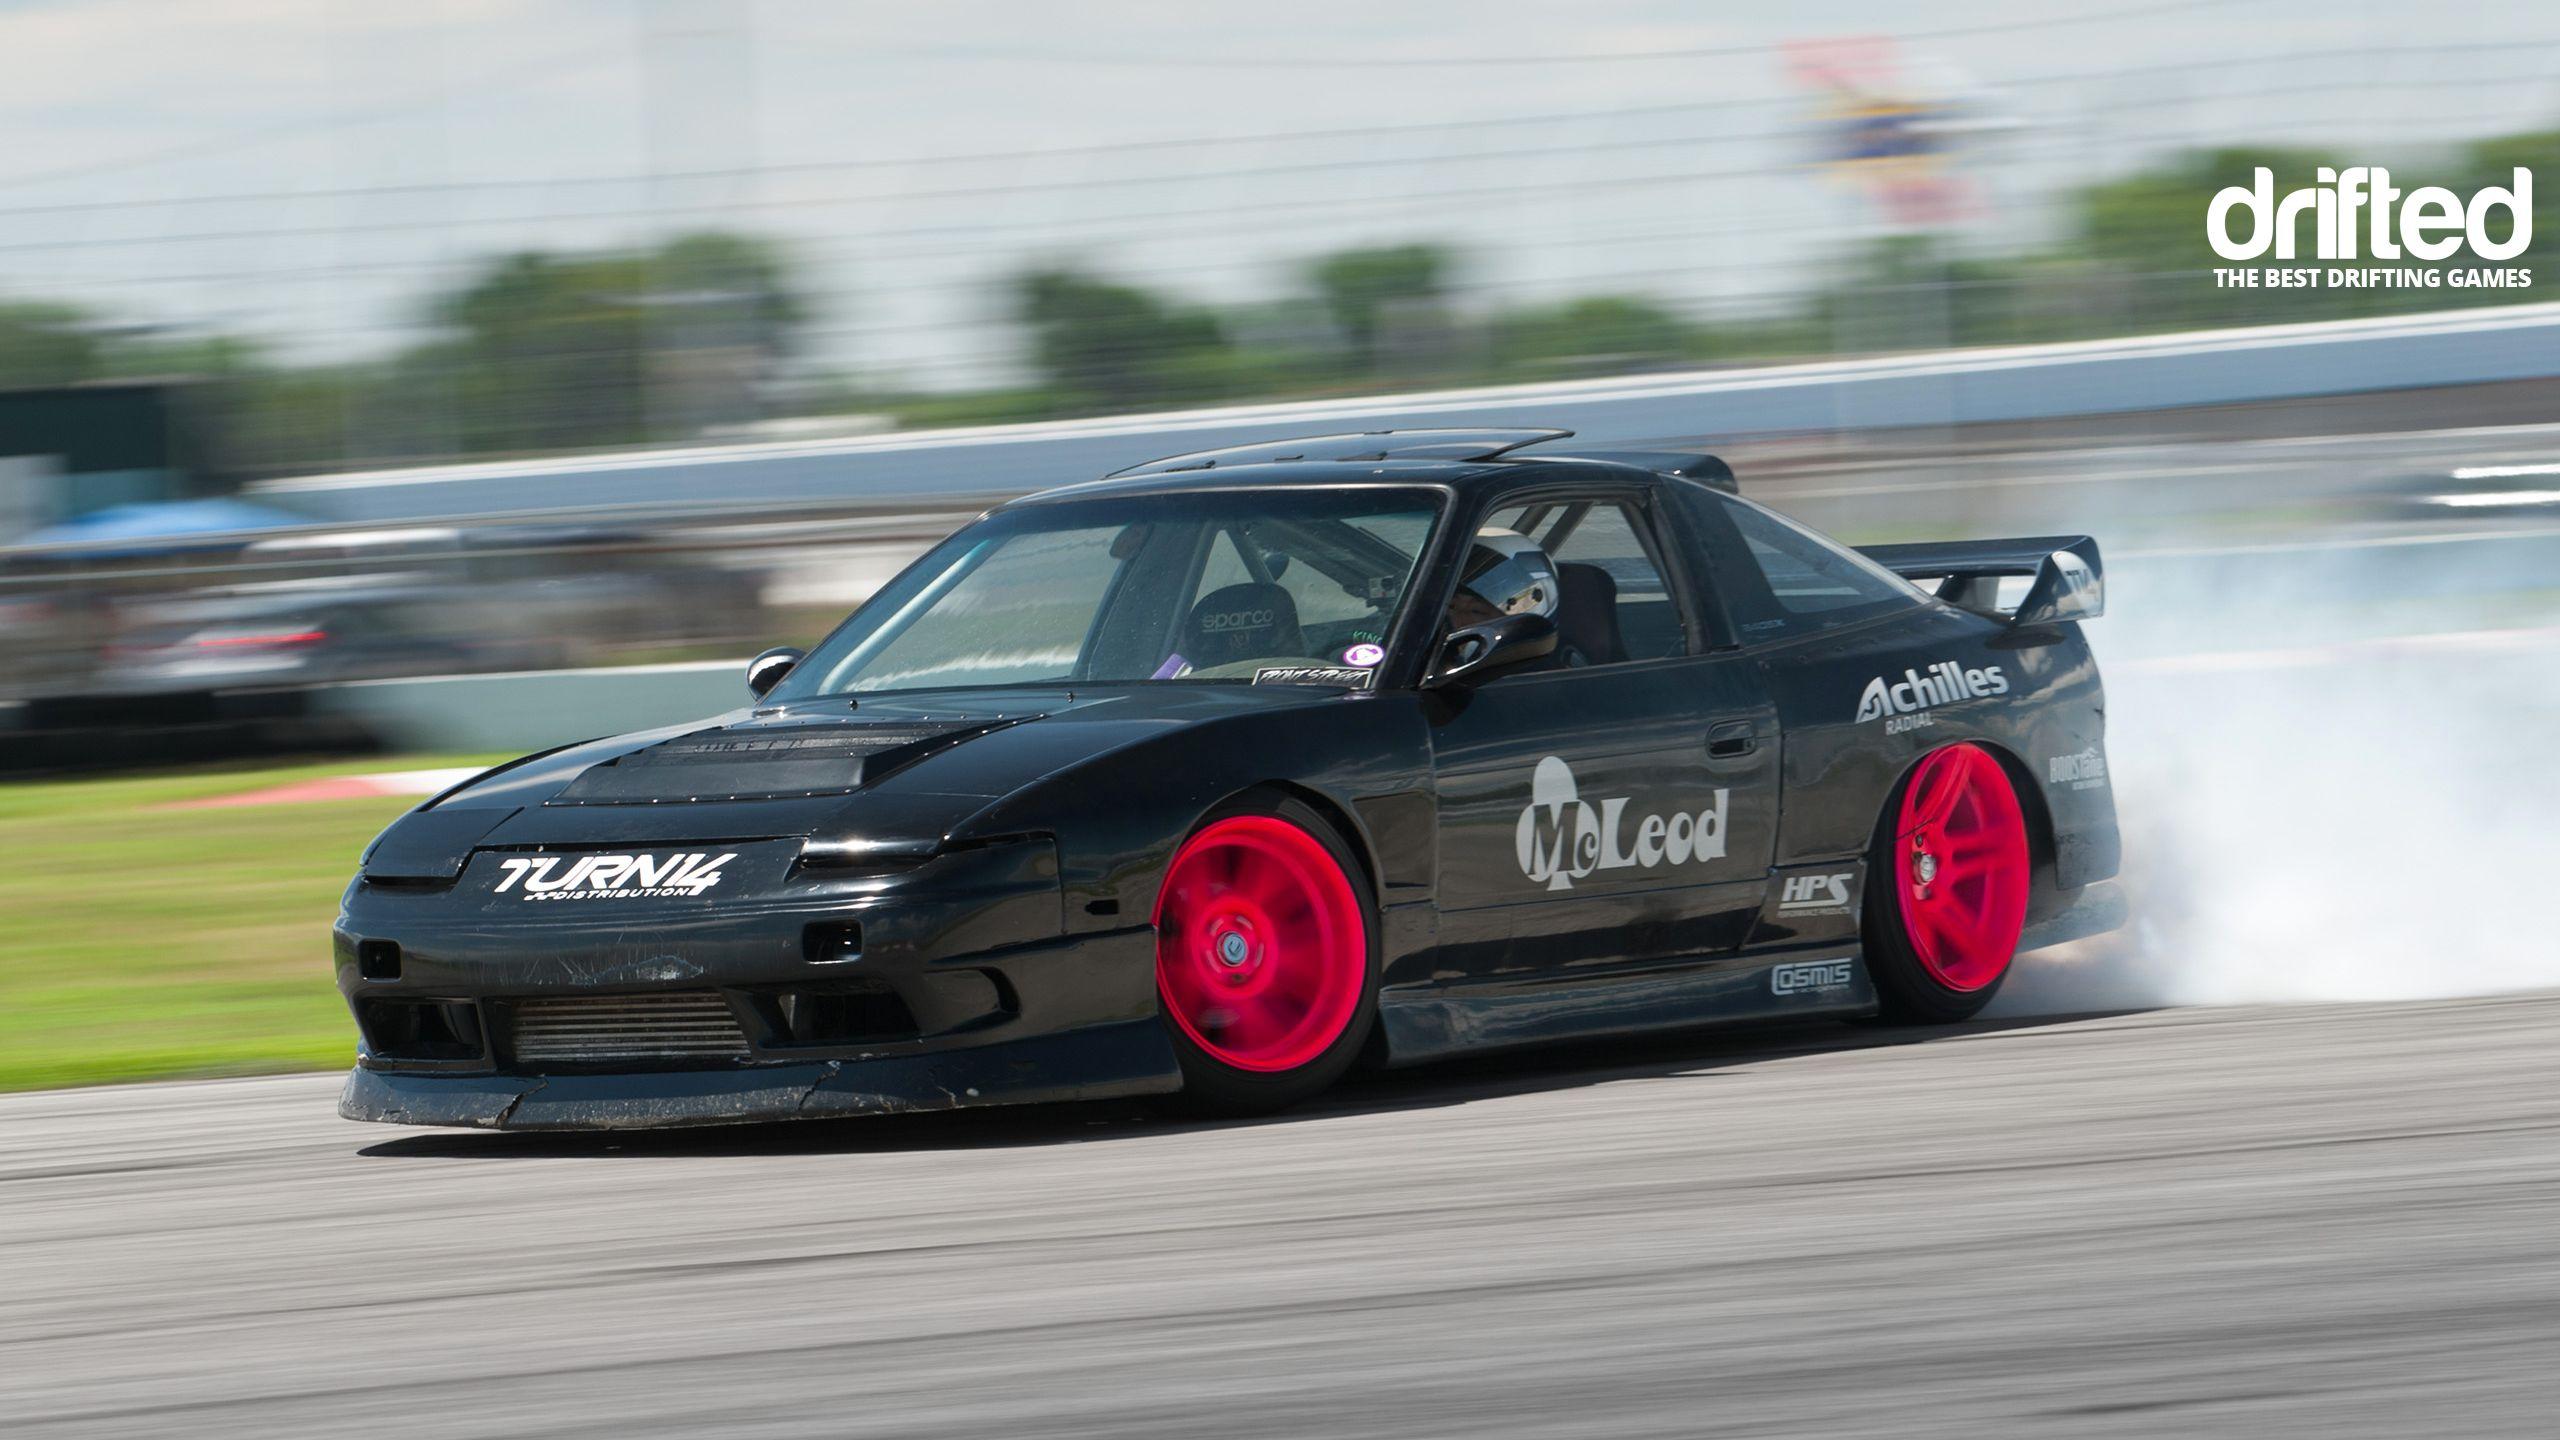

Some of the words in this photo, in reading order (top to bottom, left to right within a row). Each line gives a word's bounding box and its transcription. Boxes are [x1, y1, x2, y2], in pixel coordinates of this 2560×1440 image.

[1201, 609, 1274, 632] sparco
[1855, 660, 2009, 724] Achilles
[1886, 712, 1934, 736] RADIAL
[1518, 788, 1729, 878] McLeod
[494, 853, 738, 896] TURN14
[1779, 873, 1854, 909] HPS
[555, 886, 690, 900] DISTRIBUTION
